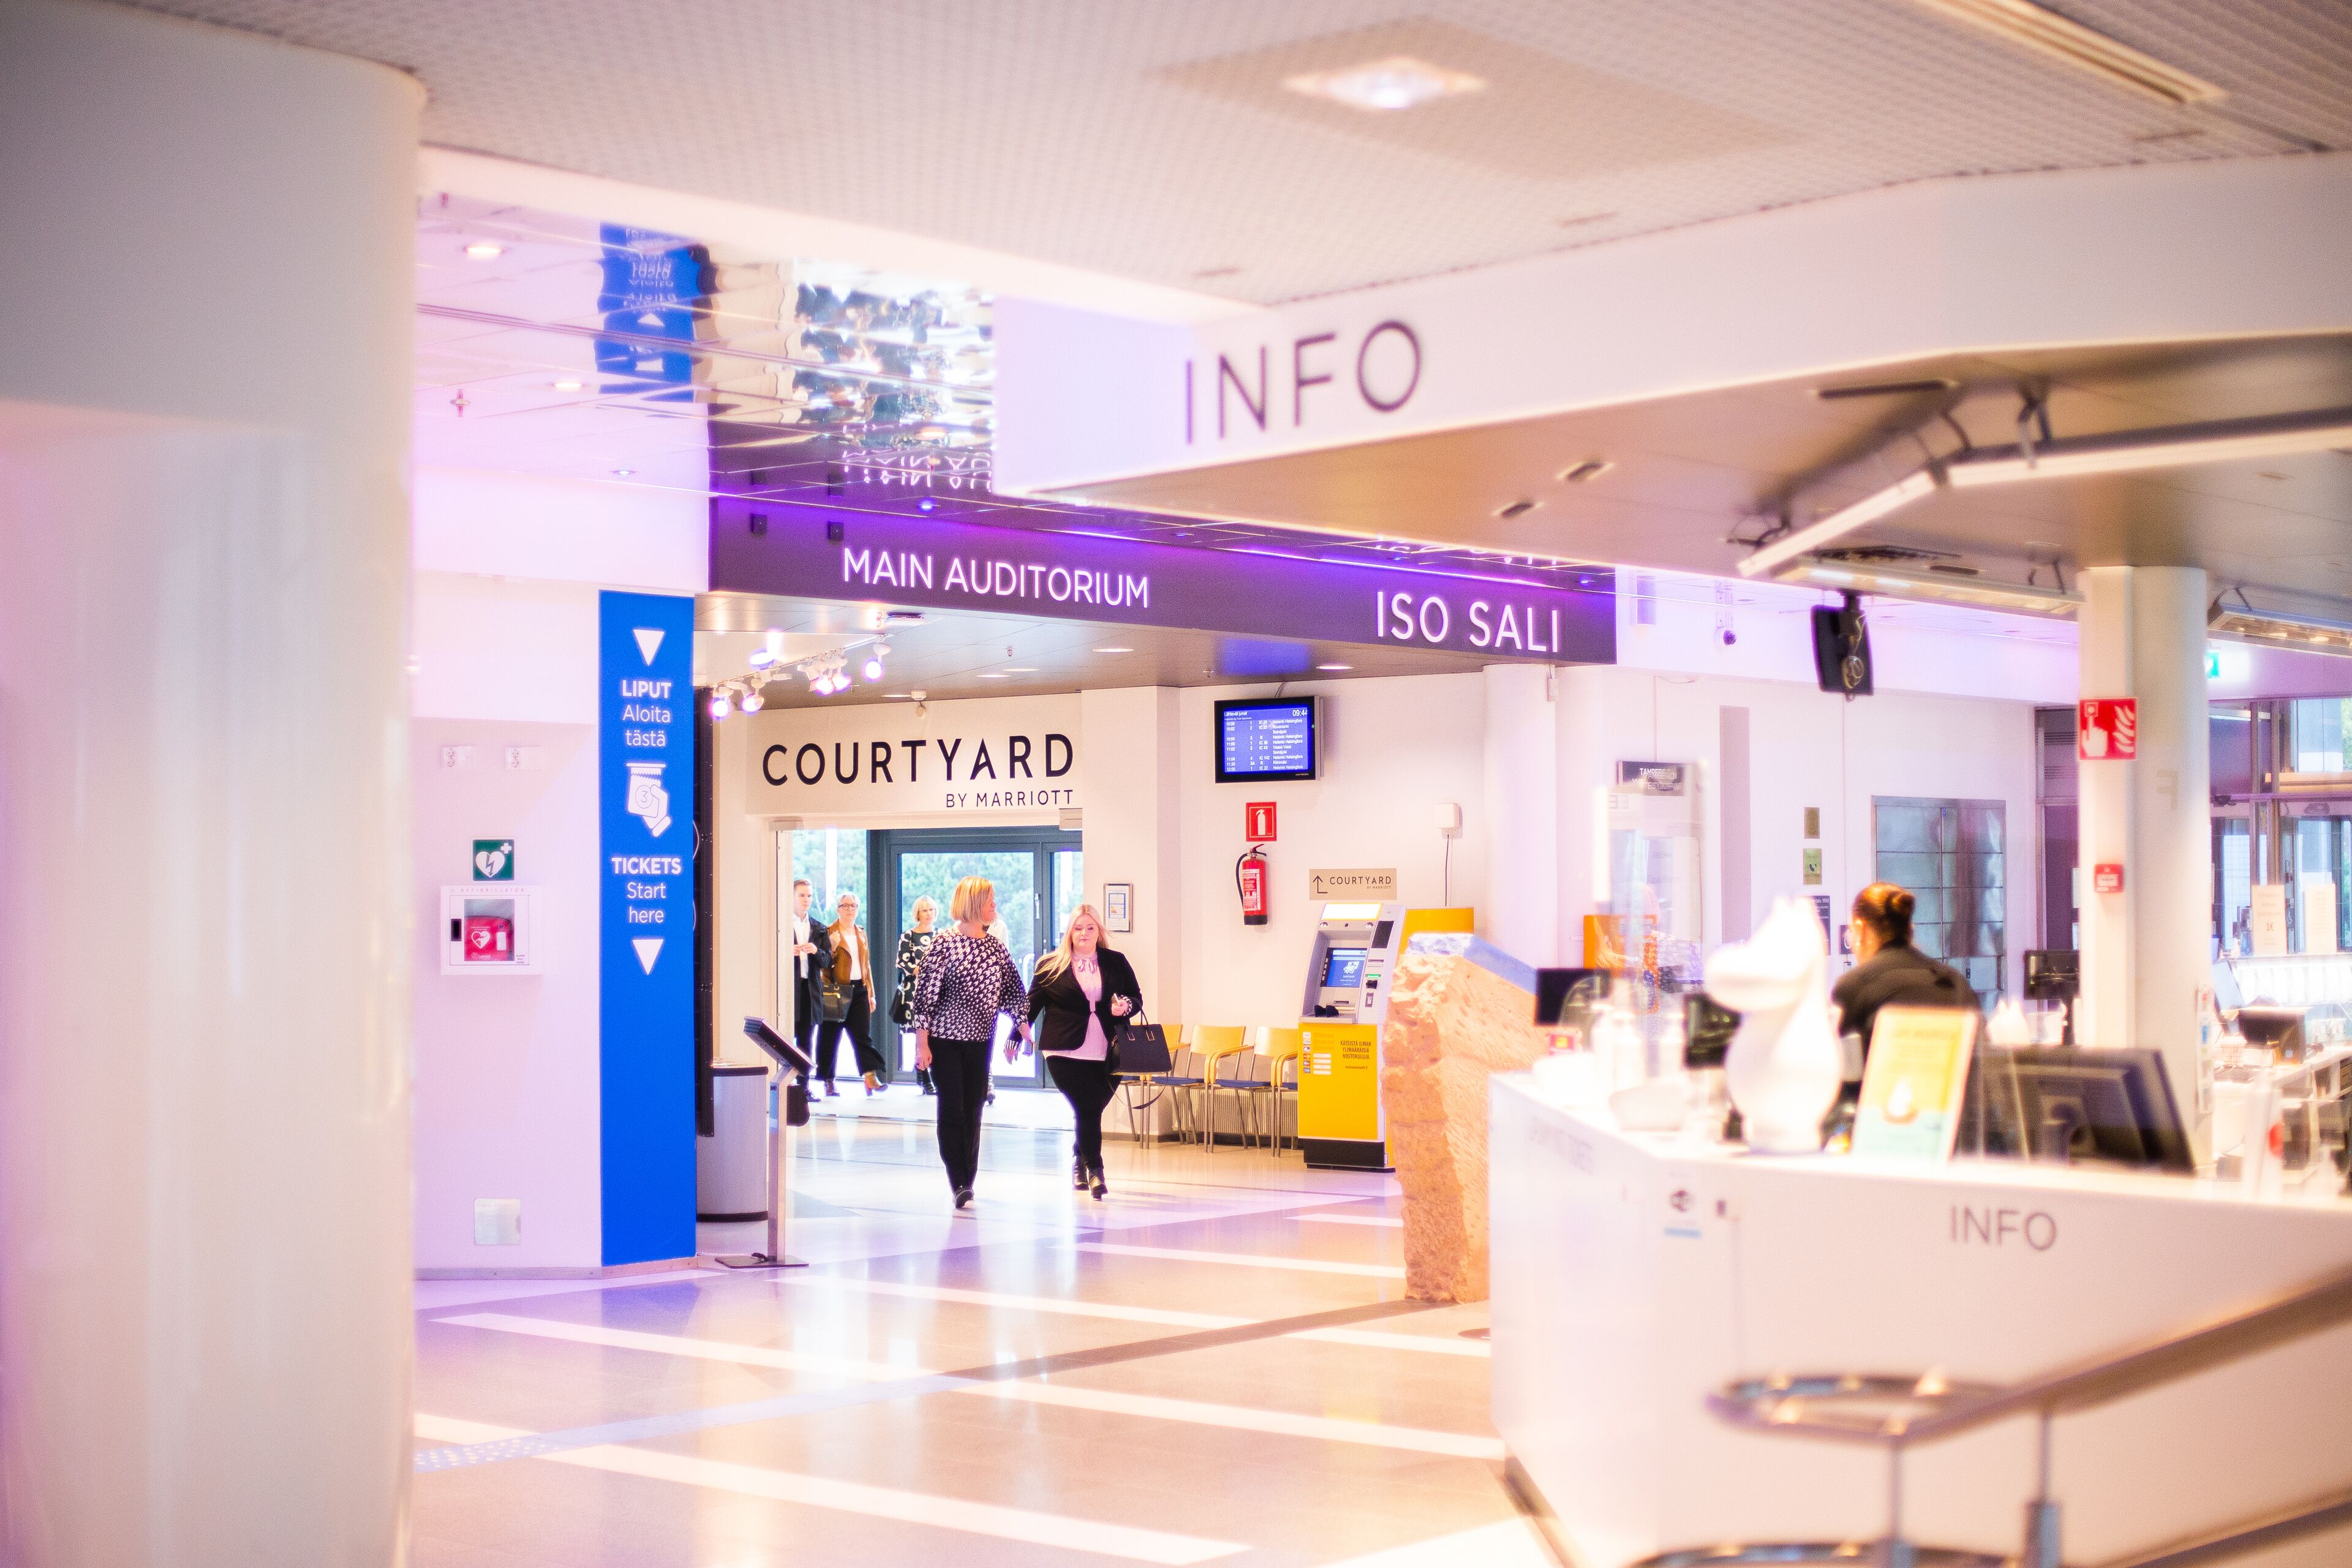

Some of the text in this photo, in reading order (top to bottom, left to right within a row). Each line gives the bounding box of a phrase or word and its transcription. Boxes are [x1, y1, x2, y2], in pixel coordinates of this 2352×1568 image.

[1186, 320, 1421, 444] INFO
[845, 548, 1148, 608] MAIN AUDITORIUM
[1377, 591, 1558, 653] ISO SALI
[622, 680, 671, 698] LIPUT
[623, 705, 671, 723] Aloita
[626, 729, 665, 747] tästä
[763, 733, 1073, 786] COURTYARD
[946, 790, 1073, 808] BY MARRIOTT
[611, 857, 682, 875] TICKETS
[627, 882, 666, 899] Start
[629, 907, 664, 923] here
[1950, 1205, 2057, 1251] INFO
